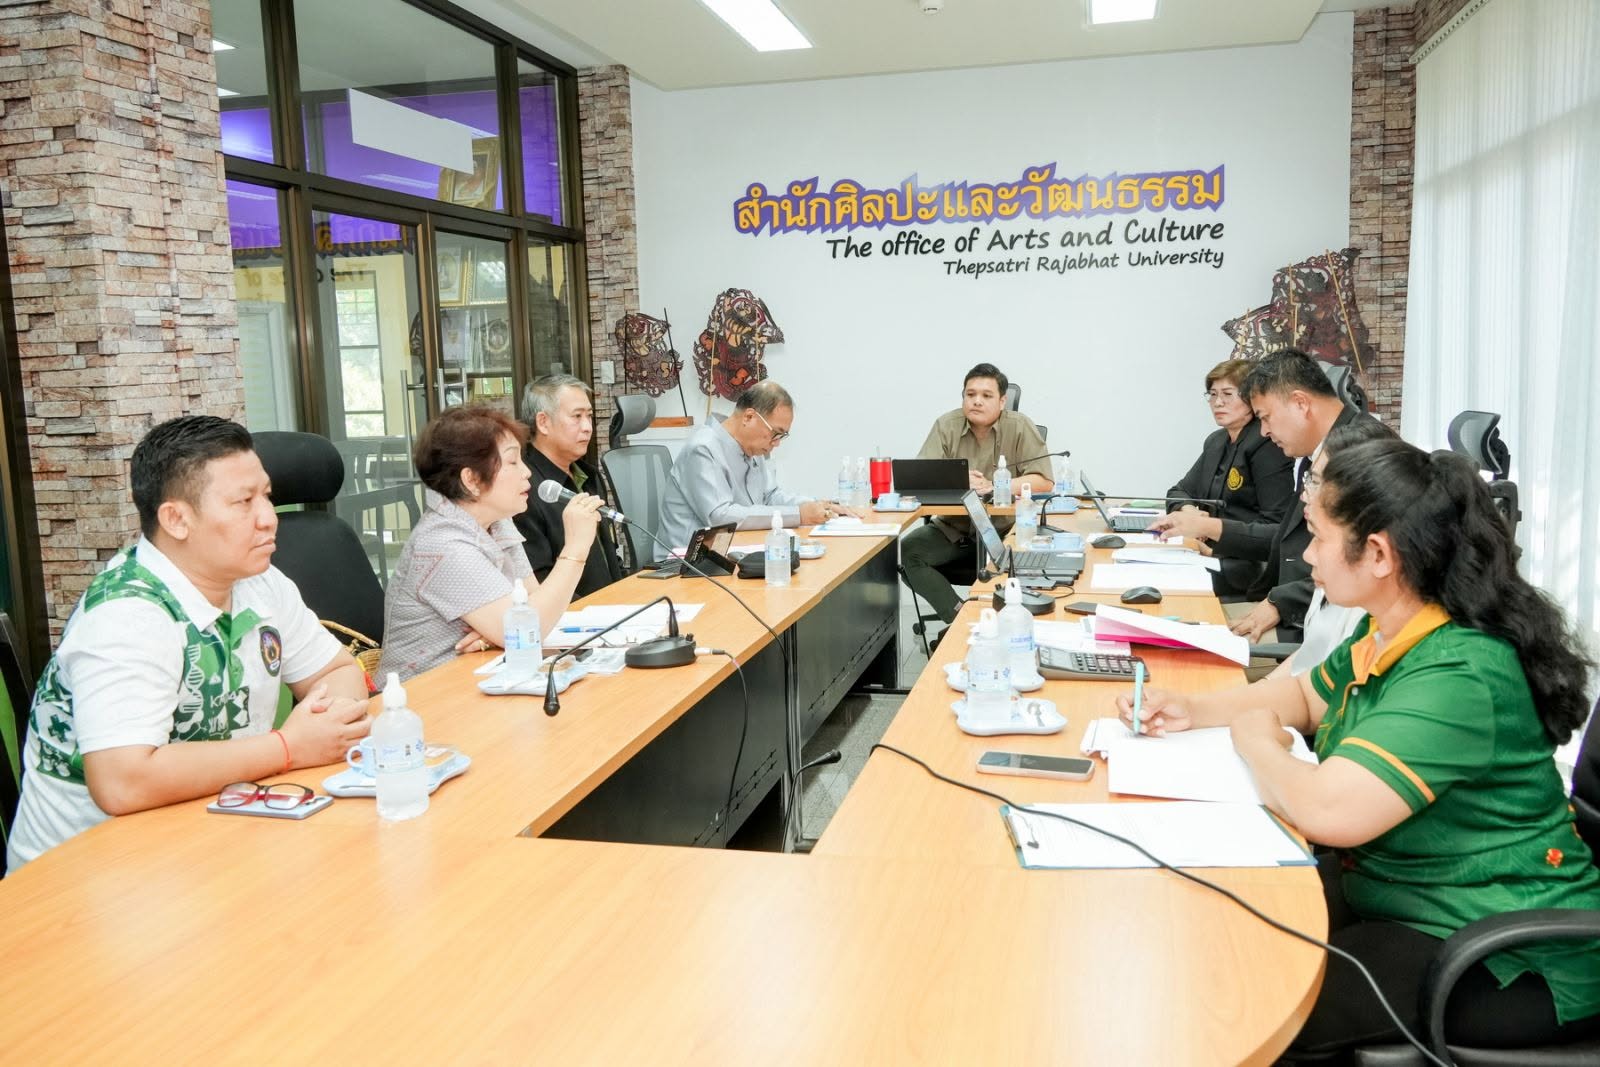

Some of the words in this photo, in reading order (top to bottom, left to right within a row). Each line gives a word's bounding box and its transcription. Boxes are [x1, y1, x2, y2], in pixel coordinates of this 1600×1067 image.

[736, 166, 1221, 230] สำนักศิลปะและวัฒนธรรม
[826, 236, 872, 258] The
[881, 230, 946, 255] office
[954, 227, 980, 253] of
[986, 229, 1050, 251] Arts
[1060, 221, 1113, 248] and
[1123, 218, 1225, 244] Culture
[943, 257, 1030, 279] Thepsatri
[1036, 252, 1119, 274] Rajabhat
[1127, 248, 1224, 268] University
